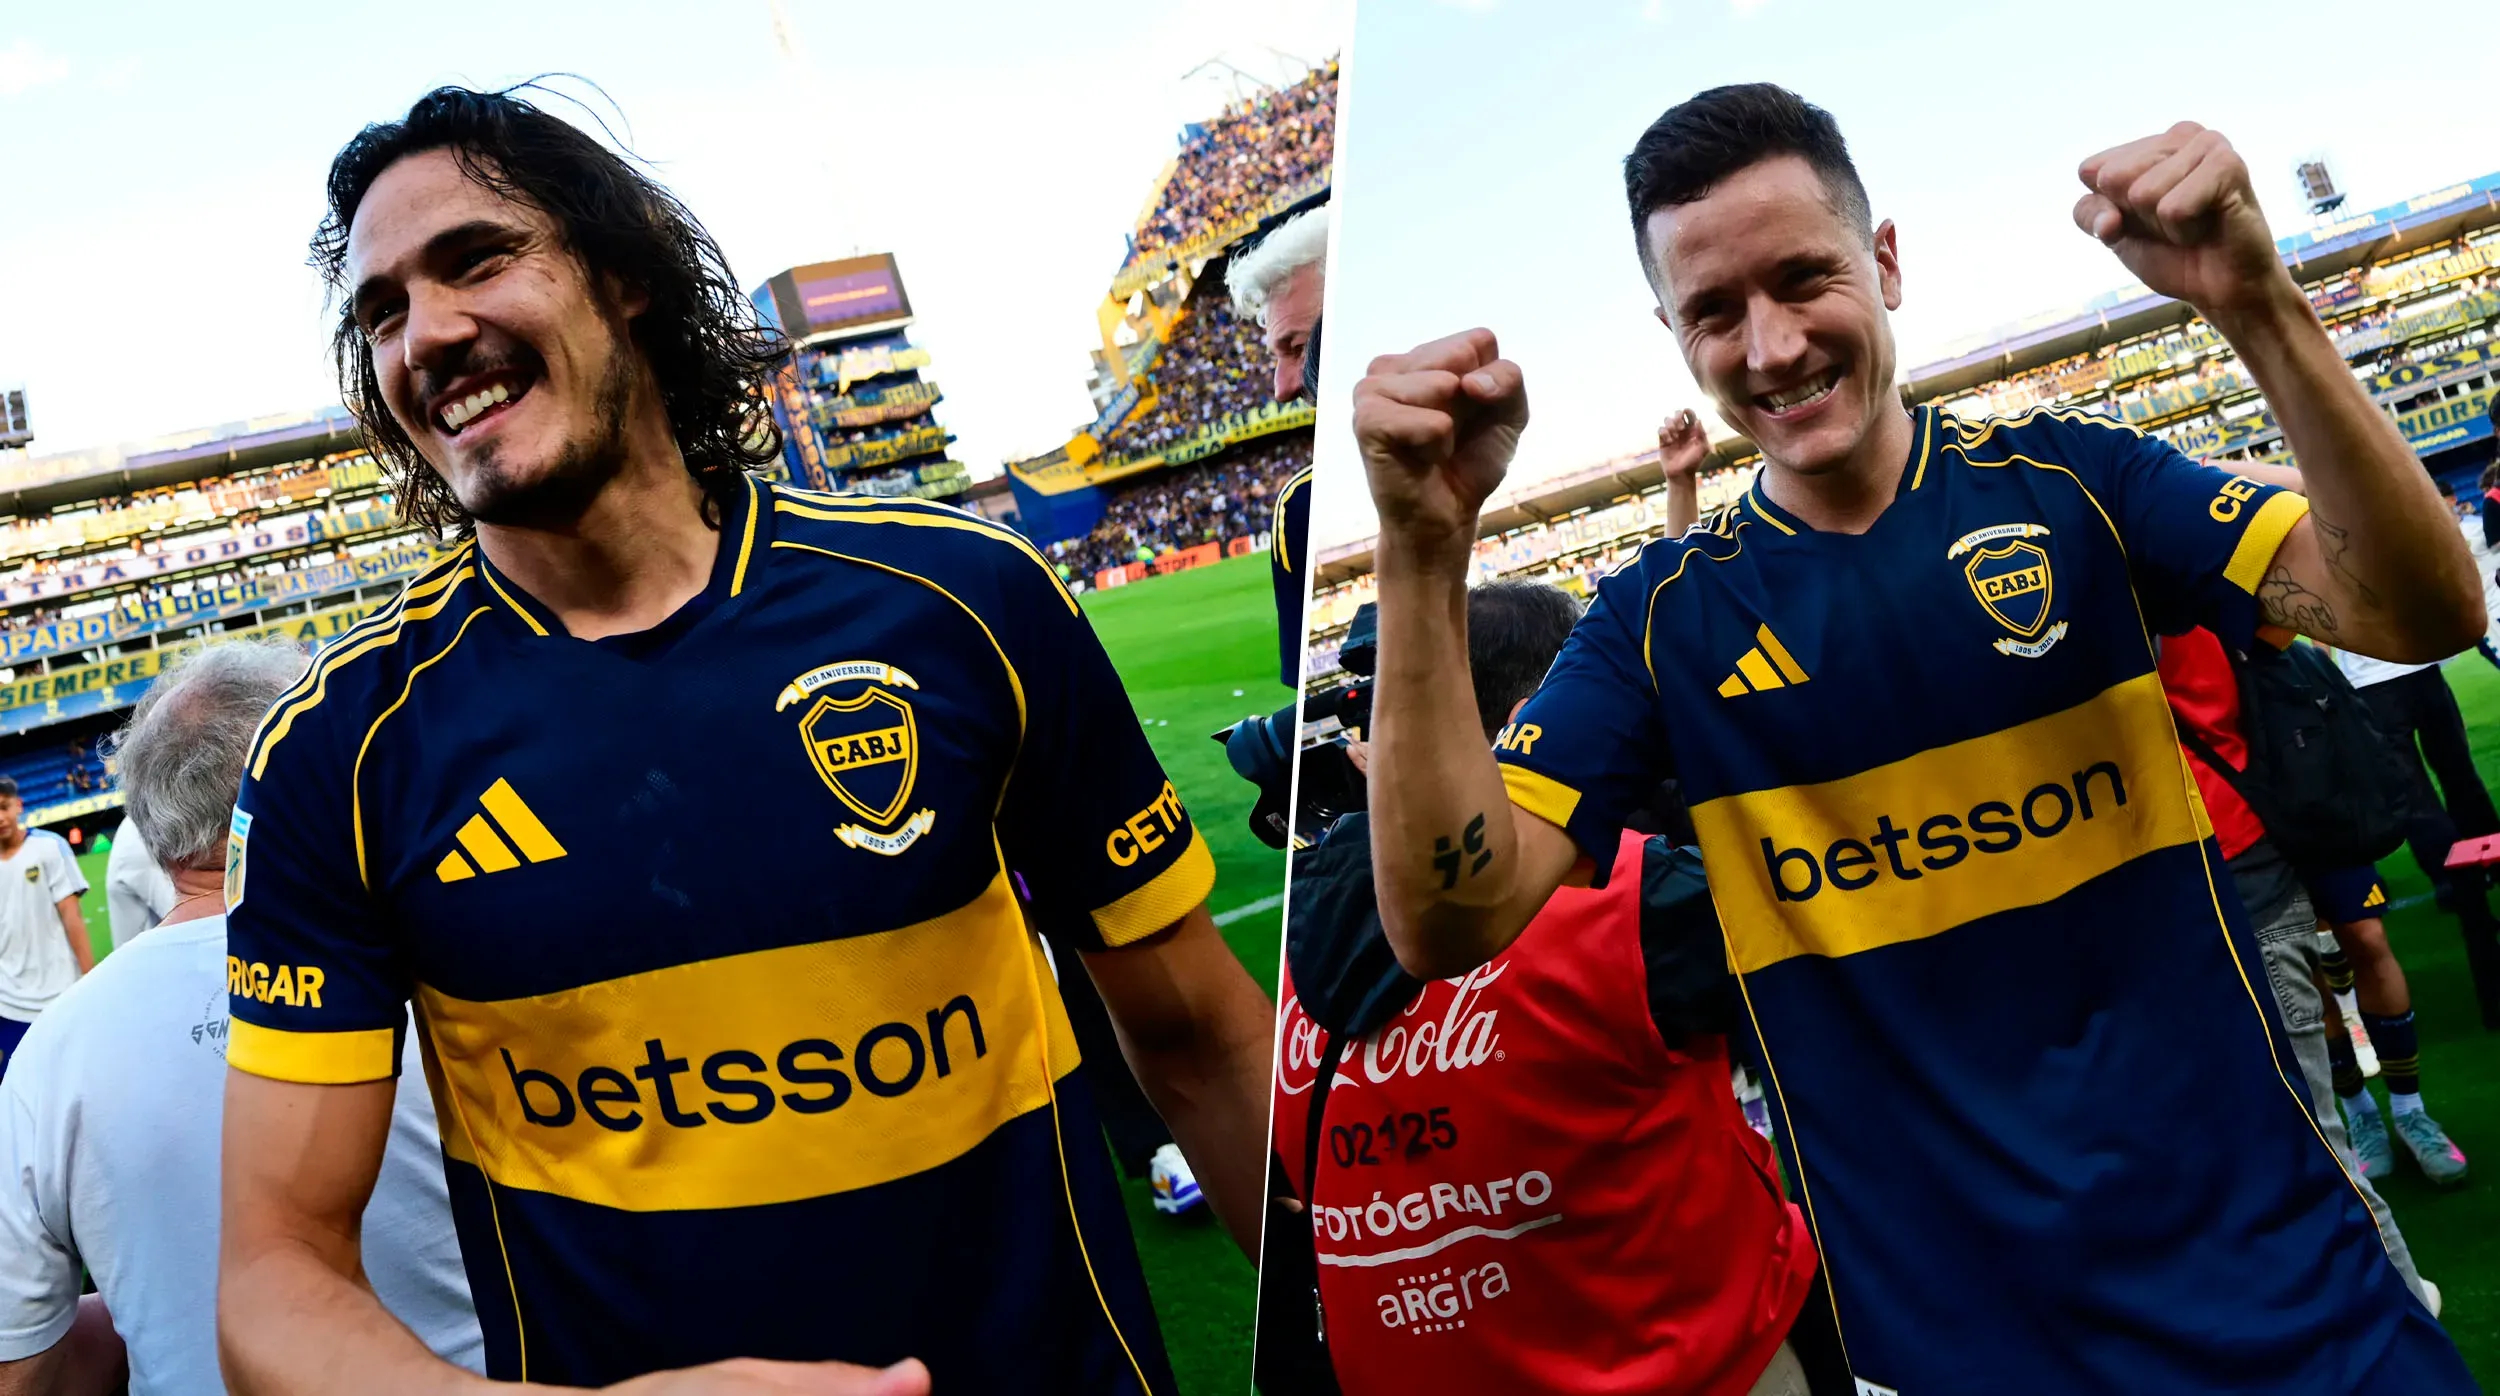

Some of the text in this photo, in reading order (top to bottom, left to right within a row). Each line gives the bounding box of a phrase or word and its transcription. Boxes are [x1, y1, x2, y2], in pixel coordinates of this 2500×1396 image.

[149, 524, 305, 570] TODOS
[1978, 526, 2023, 541] ANIVERSARIO
[1985, 570, 2042, 598] CABJ
[1, 656, 147, 706] SIEMPRE
[803, 665, 882, 688] 120 ANIVERSARIO
[826, 732, 903, 767] CABJ
[1491, 722, 1543, 756] AR
[1106, 779, 1184, 867] CETR
[1760, 760, 2127, 903] betsson
[227, 955, 325, 1009] ROGAR
[500, 994, 988, 1133] betsson
[1329, 1106, 1458, 1168] 02125
[1312, 1170, 1552, 1241] FOTÓGRAFO
